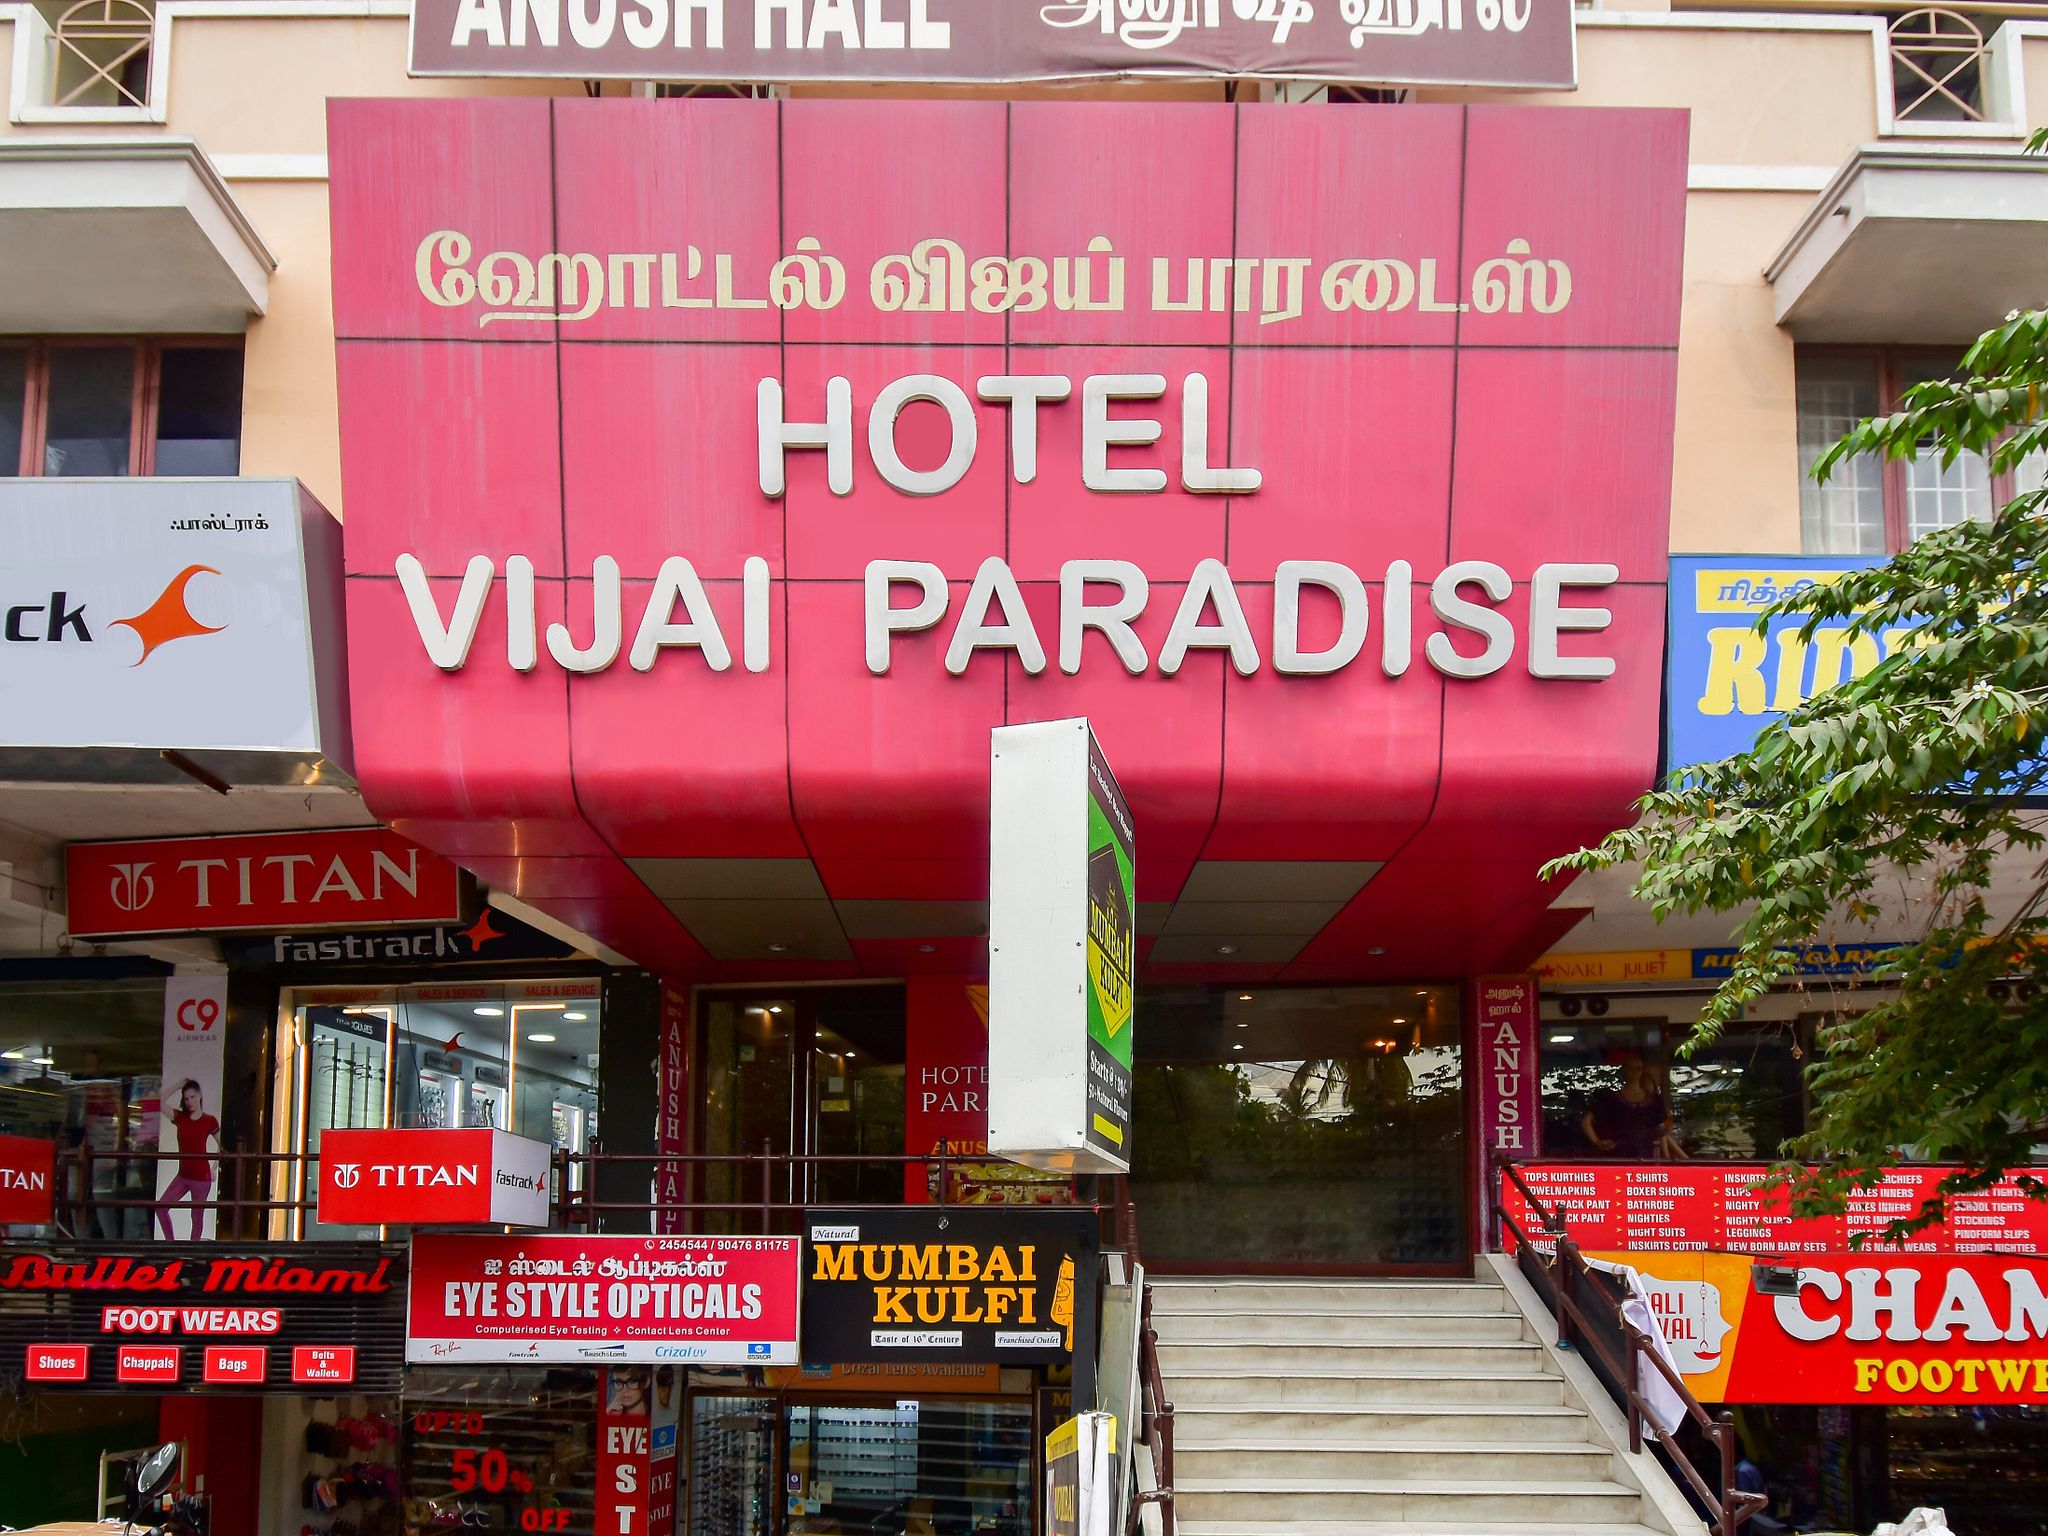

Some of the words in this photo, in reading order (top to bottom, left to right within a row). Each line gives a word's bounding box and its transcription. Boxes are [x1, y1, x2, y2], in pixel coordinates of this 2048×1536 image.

[450, 0, 724, 49] ANUSH
[754, 0, 951, 50] HALL
[415, 230, 847, 329] ஹோட்டல்
[869, 235, 1125, 313] விஜய்
[1151, 238, 1573, 326] பாரடைஸ்
[757, 372, 1263, 498] HOTEL
[395, 553, 771, 673] VIJAI
[864, 556, 1620, 680] PARADISE
[176, 848, 419, 909] TITAN
[1623, 961, 1667, 978] JULIET
[453, 988, 487, 998] SERVICE
[526, 985, 551, 996] SALES
[560, 984, 596, 995] SERVICE
[177, 999, 219, 1031] C9
[176, 1034, 217, 1043] AIRWEAR
[1090, 1049, 1108, 1080] Starts
[666, 1021, 681, 1141] ANUSH
[1493, 1021, 1523, 1149] ANUSH
[370, 1165, 478, 1187] TITAN
[496, 1170, 534, 1190] fastrack
[1524, 1172, 1548, 1182] TOPS
[1550, 1172, 1595, 1182] KURTHIES
[1635, 1173, 1669, 1182] SHIRTS
[1626, 1187, 1657, 1196] BOXER
[1659, 1187, 1695, 1196] SHORTS
[1846, 1188, 1878, 1197] LADES
[1880, 1188, 1914, 1198] INNERS
[1586, 1200, 1611, 1209] PANT
[1627, 1200, 1675, 1210] BATHROBE
[1725, 1201, 1760, 1210] NIGHTY
[1878, 1202, 1912, 1212] INNERS
[1991, 1202, 2025, 1212] TIGHTS
[1581, 1213, 1606, 1223] PANT
[1627, 1214, 1671, 1223] NIGHTIES
[1726, 1217, 1760, 1225] NIGHTY
[1846, 1215, 1871, 1224] BOYS
[1954, 1216, 2006, 1225] STOCKINGS
[814, 1229, 855, 1240] Natural
[1627, 1228, 1656, 1237] NIGHT
[1658, 1228, 1686, 1237] SUITS
[1726, 1228, 1772, 1237] LEGGINGS
[2003, 1230, 2030, 1239] SLIPS
[659, 1240, 708, 1250] 2454544
[717, 1240, 752, 1250] 90476
[754, 1241, 789, 1251] 81175
[1628, 1241, 1670, 1251] INSKIRTS
[1672, 1241, 1709, 1251] COTTON
[1726, 1242, 1748, 1251] NEW
[1750, 1242, 1775, 1251] BORN
[1777, 1242, 1802, 1251] BABY
[1803, 1242, 1827, 1252] SETS
[1904, 1243, 1937, 1252] WEARS
[1955, 1244, 1993, 1252] FEEDING
[1994, 1244, 2037, 1253] NIGHTIES
[812, 1244, 1037, 1282] MUMBAI
[0, 1254, 184, 1291] Bullet
[203, 1257, 391, 1293] Miami
[445, 1282, 497, 1317] EYE
[506, 1282, 599, 1318] STYLE
[607, 1282, 762, 1319] OPTICALS
[873, 1286, 1037, 1323] KULFI
[103, 1309, 175, 1332] FOOT
[182, 1310, 278, 1332] WEARS
[475, 1325, 547, 1335] Computerised
[549, 1326, 568, 1335] Eye
[571, 1326, 608, 1336] Testing
[627, 1326, 667, 1335] Contact
[669, 1326, 693, 1335] Lens
[695, 1327, 730, 1335] Center
[875, 1335, 897, 1344] Taste
[901, 1335, 910, 1344] of
[928, 1335, 960, 1345] Century
[997, 1335, 1035, 1344] Franchised
[1036, 1335, 1059, 1344] Outlet
[312, 1351, 335, 1360] Belts
[655, 1346, 690, 1358] Crizal
[38, 1355, 75, 1369] Shoes
[123, 1355, 174, 1371] Chappals
[219, 1357, 247, 1373] Bags
[306, 1369, 340, 1378] Wallets
[885, 1363, 917, 1376] Lens
[921, 1363, 986, 1376] Available
[415, 1411, 484, 1434] UPTO
[607, 1426, 648, 1454] EYE
[651, 1472, 672, 1494] EYE
[521, 1507, 572, 1533] OFF
